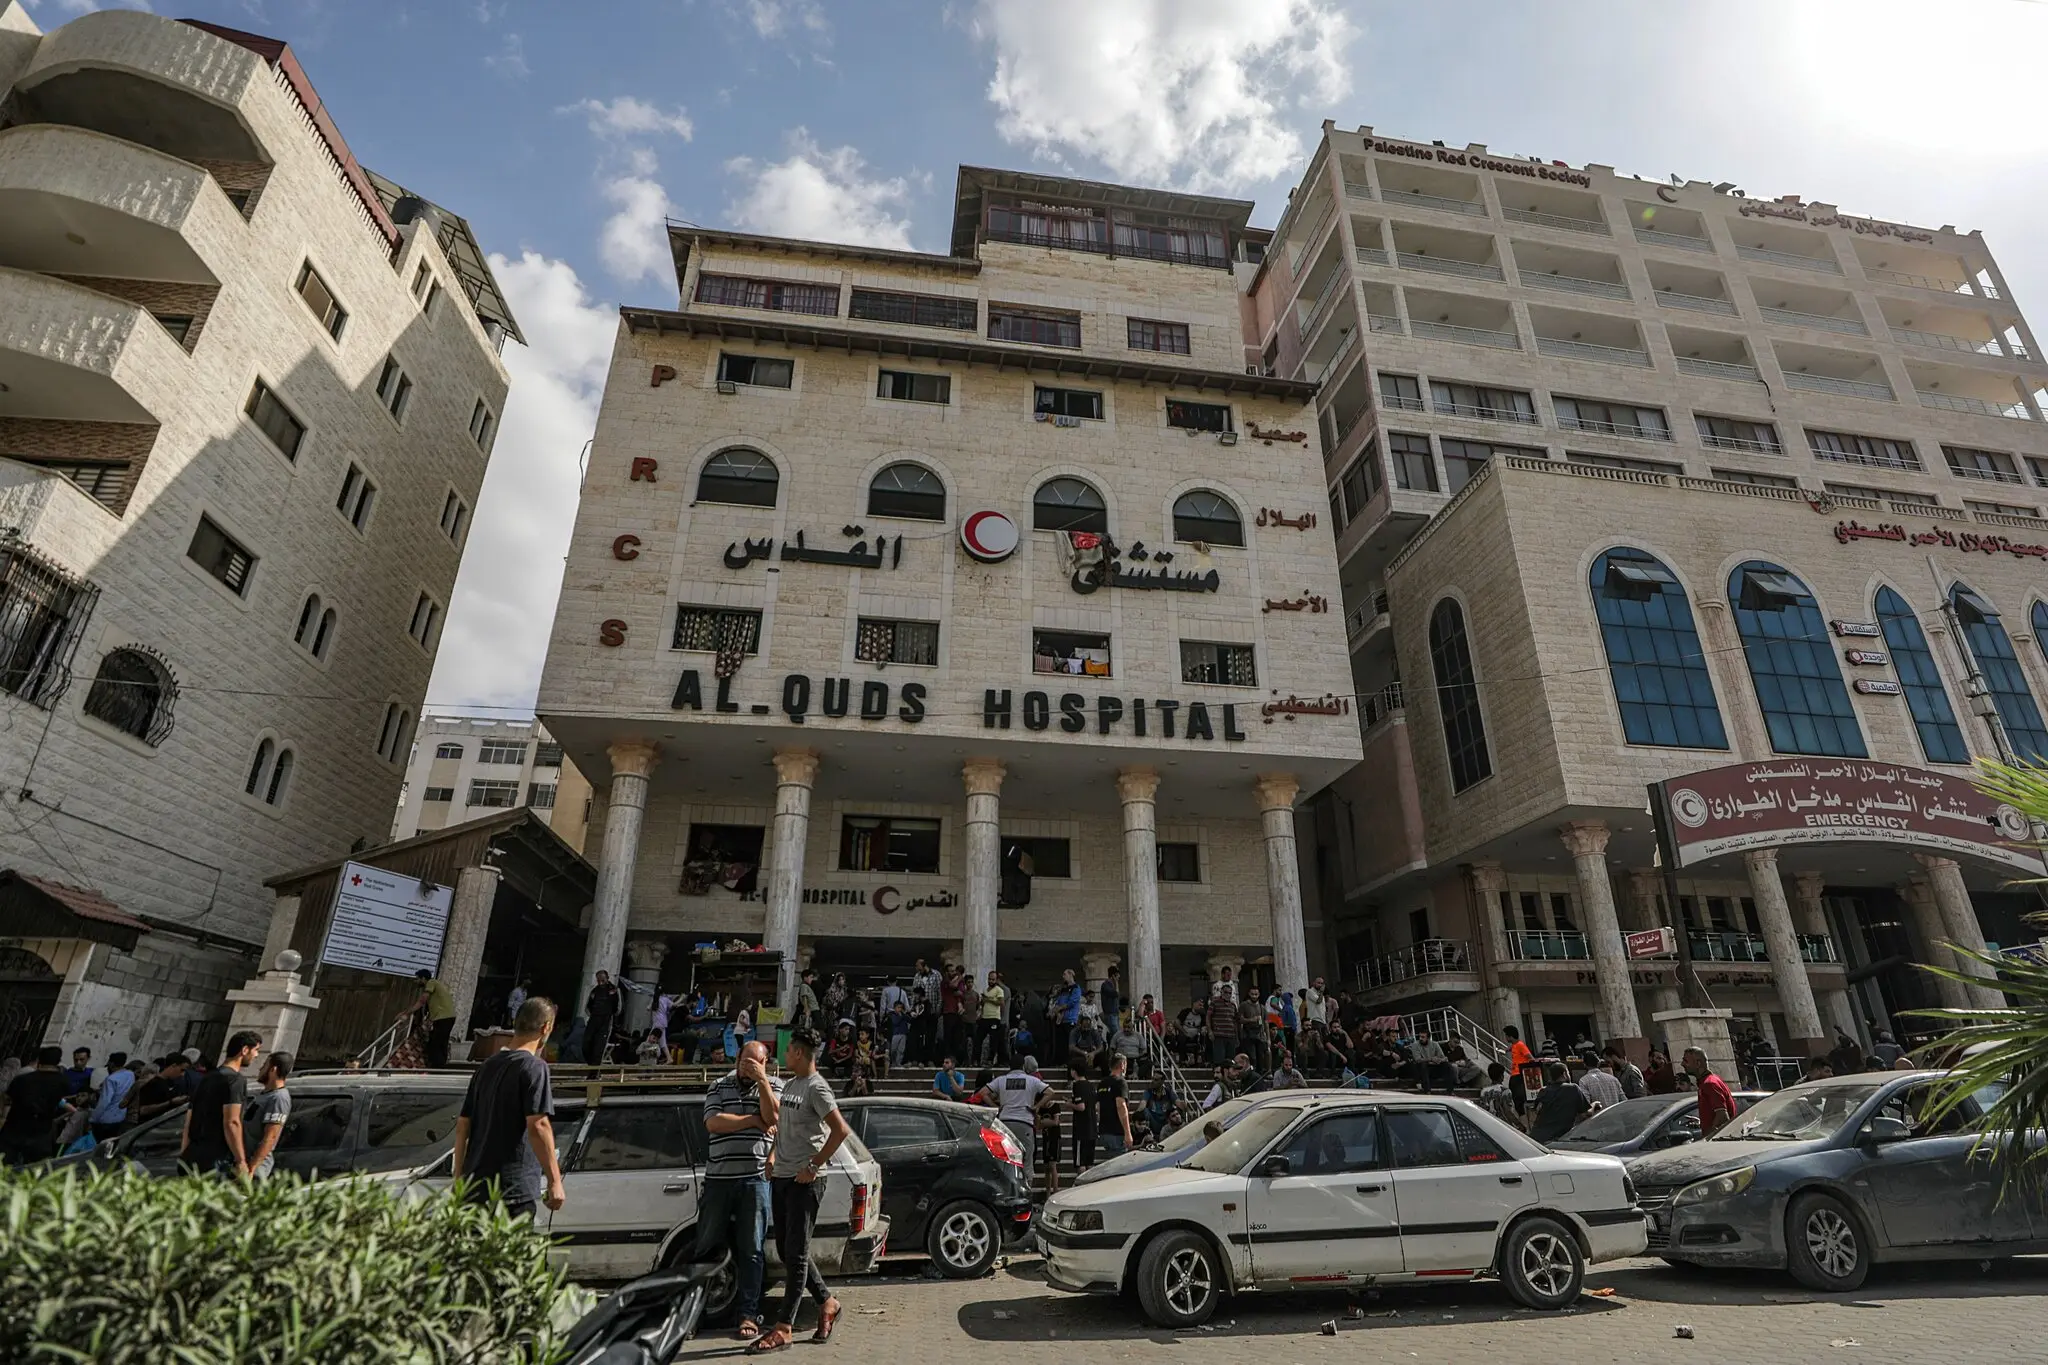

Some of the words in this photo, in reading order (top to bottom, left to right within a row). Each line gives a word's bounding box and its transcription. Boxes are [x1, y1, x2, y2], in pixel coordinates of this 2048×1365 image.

[1363, 138, 1433, 161] Palestine
[1436, 149, 1467, 166] Red
[1469, 155, 1536, 177] Crescent
[1538, 166, 1591, 188] Society
[1246, 420, 1308, 448] جمعية
[1256, 507, 1317, 531] الهلال
[723, 524, 902, 569] القدس
[984, 689, 1246, 741] HOSPITAL
[1261, 689, 1349, 724] الفلسطيني
[1814, 761, 1857, 779] الأحمر
[1860, 763, 1900, 783] الهلال
[1901, 768, 1943, 792] جمعية
[1788, 785, 1841, 813] مدخل
[1856, 790, 1918, 813] القدس
[1805, 813, 1909, 830] EMERGENCY
[802, 889, 866, 906] HOSPITAL
[905, 890, 958, 911] القدس
